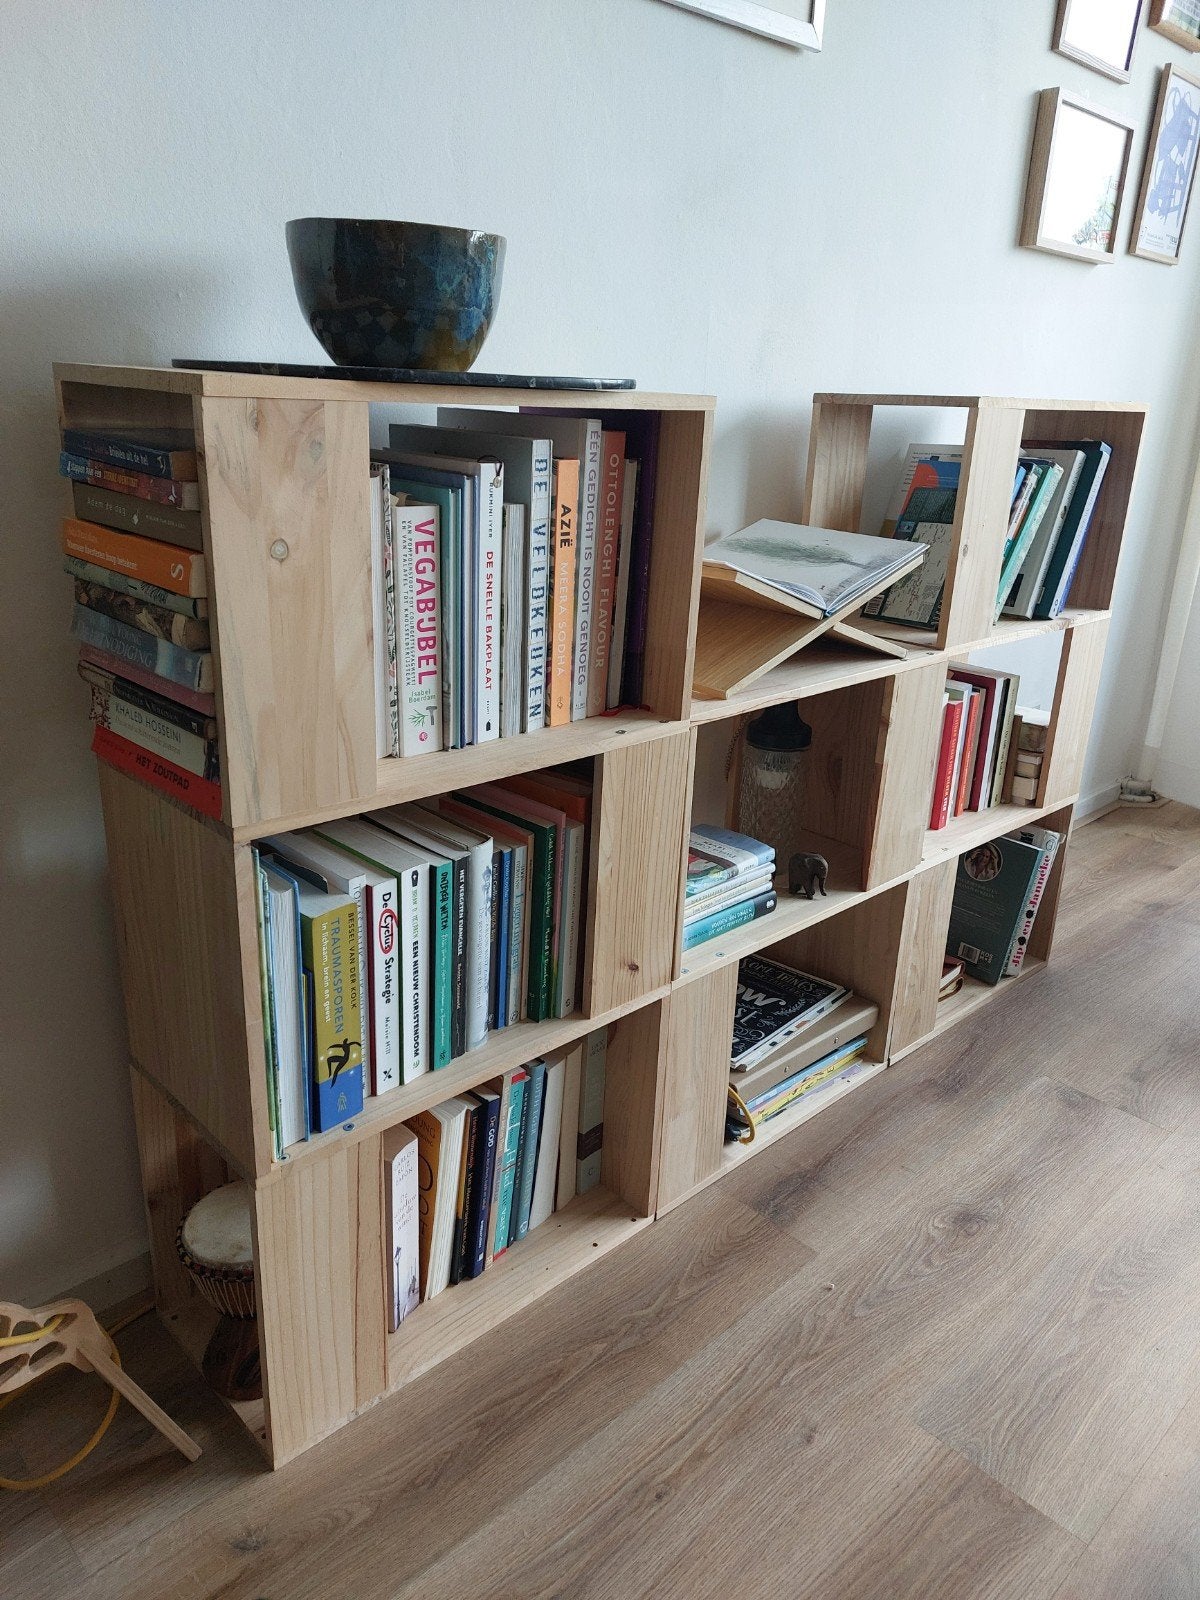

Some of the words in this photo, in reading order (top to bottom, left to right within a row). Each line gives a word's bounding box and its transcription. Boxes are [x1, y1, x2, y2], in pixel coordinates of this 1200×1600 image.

[588, 430, 601, 462] ÉÉN
[533, 458, 548, 493] DE
[583, 469, 597, 540] GEDICHT
[601, 453, 619, 577] OTTOLENGHI
[401, 520, 406, 529] EN
[560, 504, 573, 548] AZIË
[485, 551, 493, 568] DE
[583, 546, 593, 560] IS
[414, 518, 436, 684] VEGABIJBEL
[557, 561, 568, 614] MEERA
[580, 566, 592, 612] NOOIT
[527, 523, 546, 718] VELDKEUKEN
[594, 587, 609, 668] FLAVOUR
[556, 621, 567, 676] SODHA
[576, 620, 589, 685] GENOEG
[412, 688, 431, 698] Isabel
[115, 703, 143, 726] KHALED
[146, 717, 182, 743] HOSSEINI
[136, 753, 151, 769] HET
[153, 761, 190, 791] ZOUTPAD
[382, 892, 390, 908] De
[1010, 946, 1024, 968] Jip
[1022, 918, 1031, 935] en
[1028, 854, 1050, 909] Janneke
[320, 922, 328, 930] In
[347, 912, 355, 944] BESSEL
[380, 914, 392, 949] Cyclus
[439, 903, 448, 930] WETEN
[321, 932, 329, 964] lichaam,
[348, 947, 356, 963] VAN
[330, 917, 344, 1033] TRAUMASPOREN
[348, 967, 356, 983] DER
[381, 957, 394, 1004] Strategie
[740, 958, 775, 974] SOME
[776, 970, 818, 993] THINGS
[322, 989, 330, 999] en
[349, 986, 357, 1008] KOLK
[532, 1076, 542, 1106] EDITH
[489, 1115, 496, 1127] De
[529, 1109, 539, 1135] EGER
[487, 1128, 495, 1147] GOD
[394, 1148, 416, 1171] CARLOS
